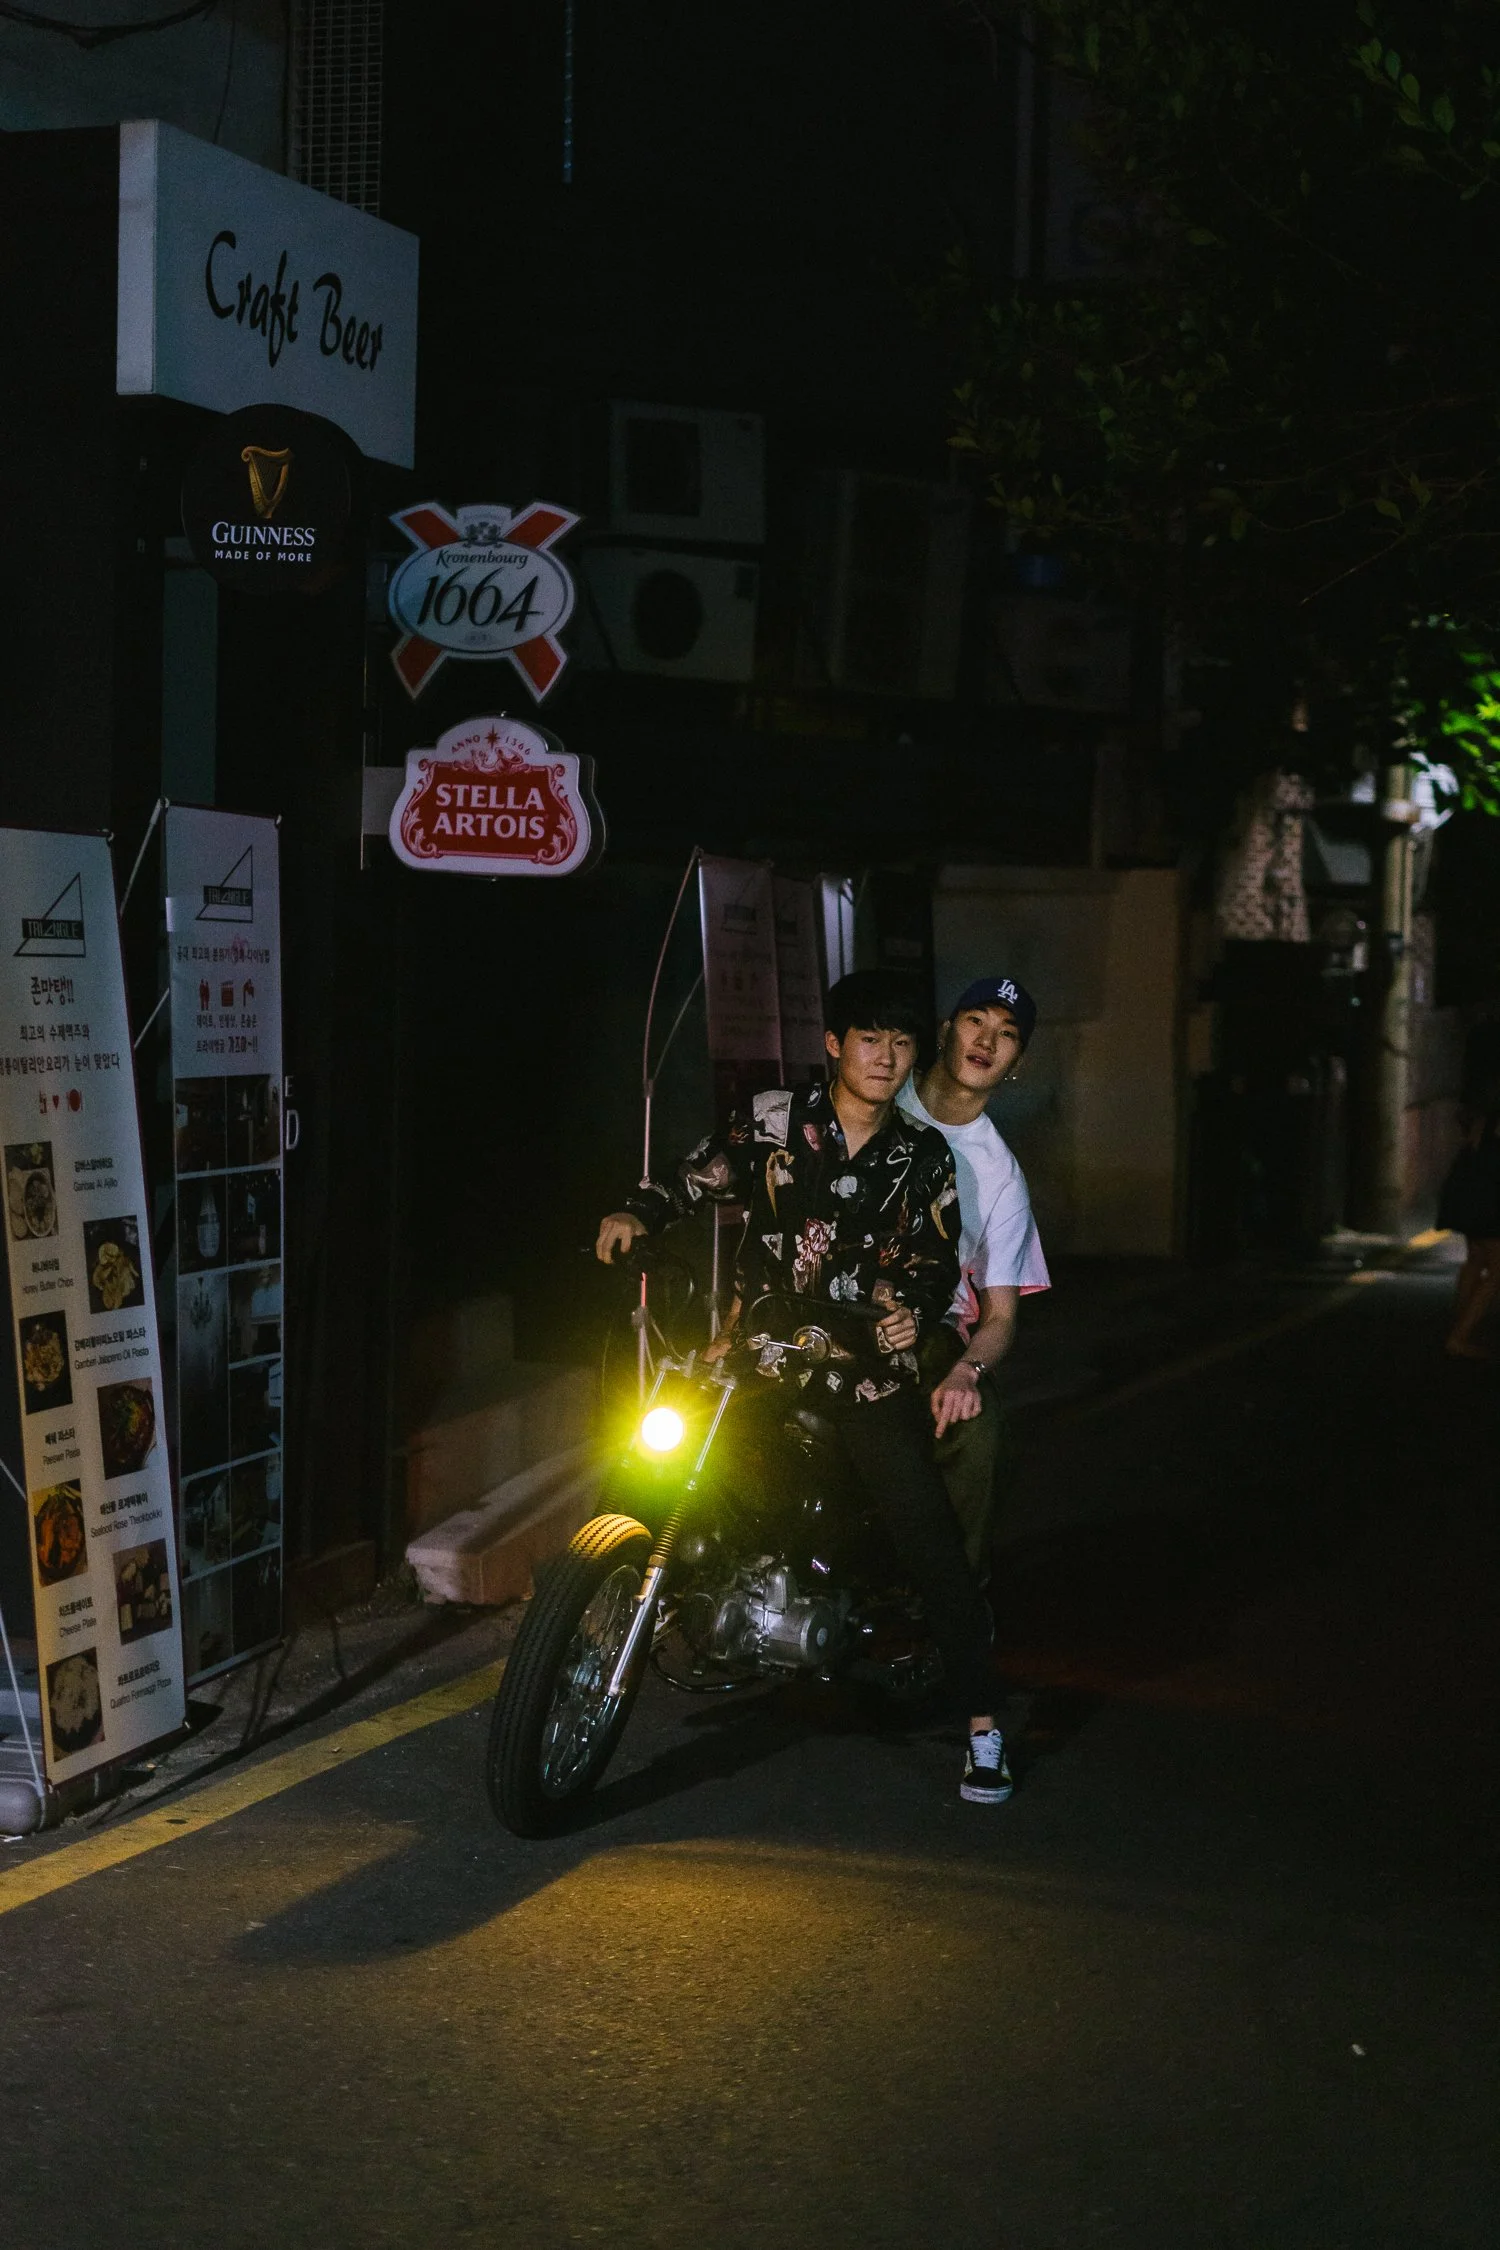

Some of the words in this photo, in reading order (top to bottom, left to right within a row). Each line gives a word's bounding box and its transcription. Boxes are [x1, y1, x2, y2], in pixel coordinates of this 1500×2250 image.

[204, 230, 299, 368] Craft
[312, 272, 382, 372] Beer
[211, 521, 316, 547] GUINNESS
[214, 550, 249, 560] MADE
[256, 551, 272, 561] OF
[277, 552, 312, 563] MORE
[436, 550, 529, 569] Kronenbourg
[416, 566, 544, 632] 1664
[452, 734, 480, 753] ANNO
[505, 736, 530, 756] 1366
[435, 783, 545, 811] STELLA
[432, 812, 545, 839] ARTOIS
[997, 979, 1018, 1004] LA
[20, 1024, 45, 1041] 최고의
